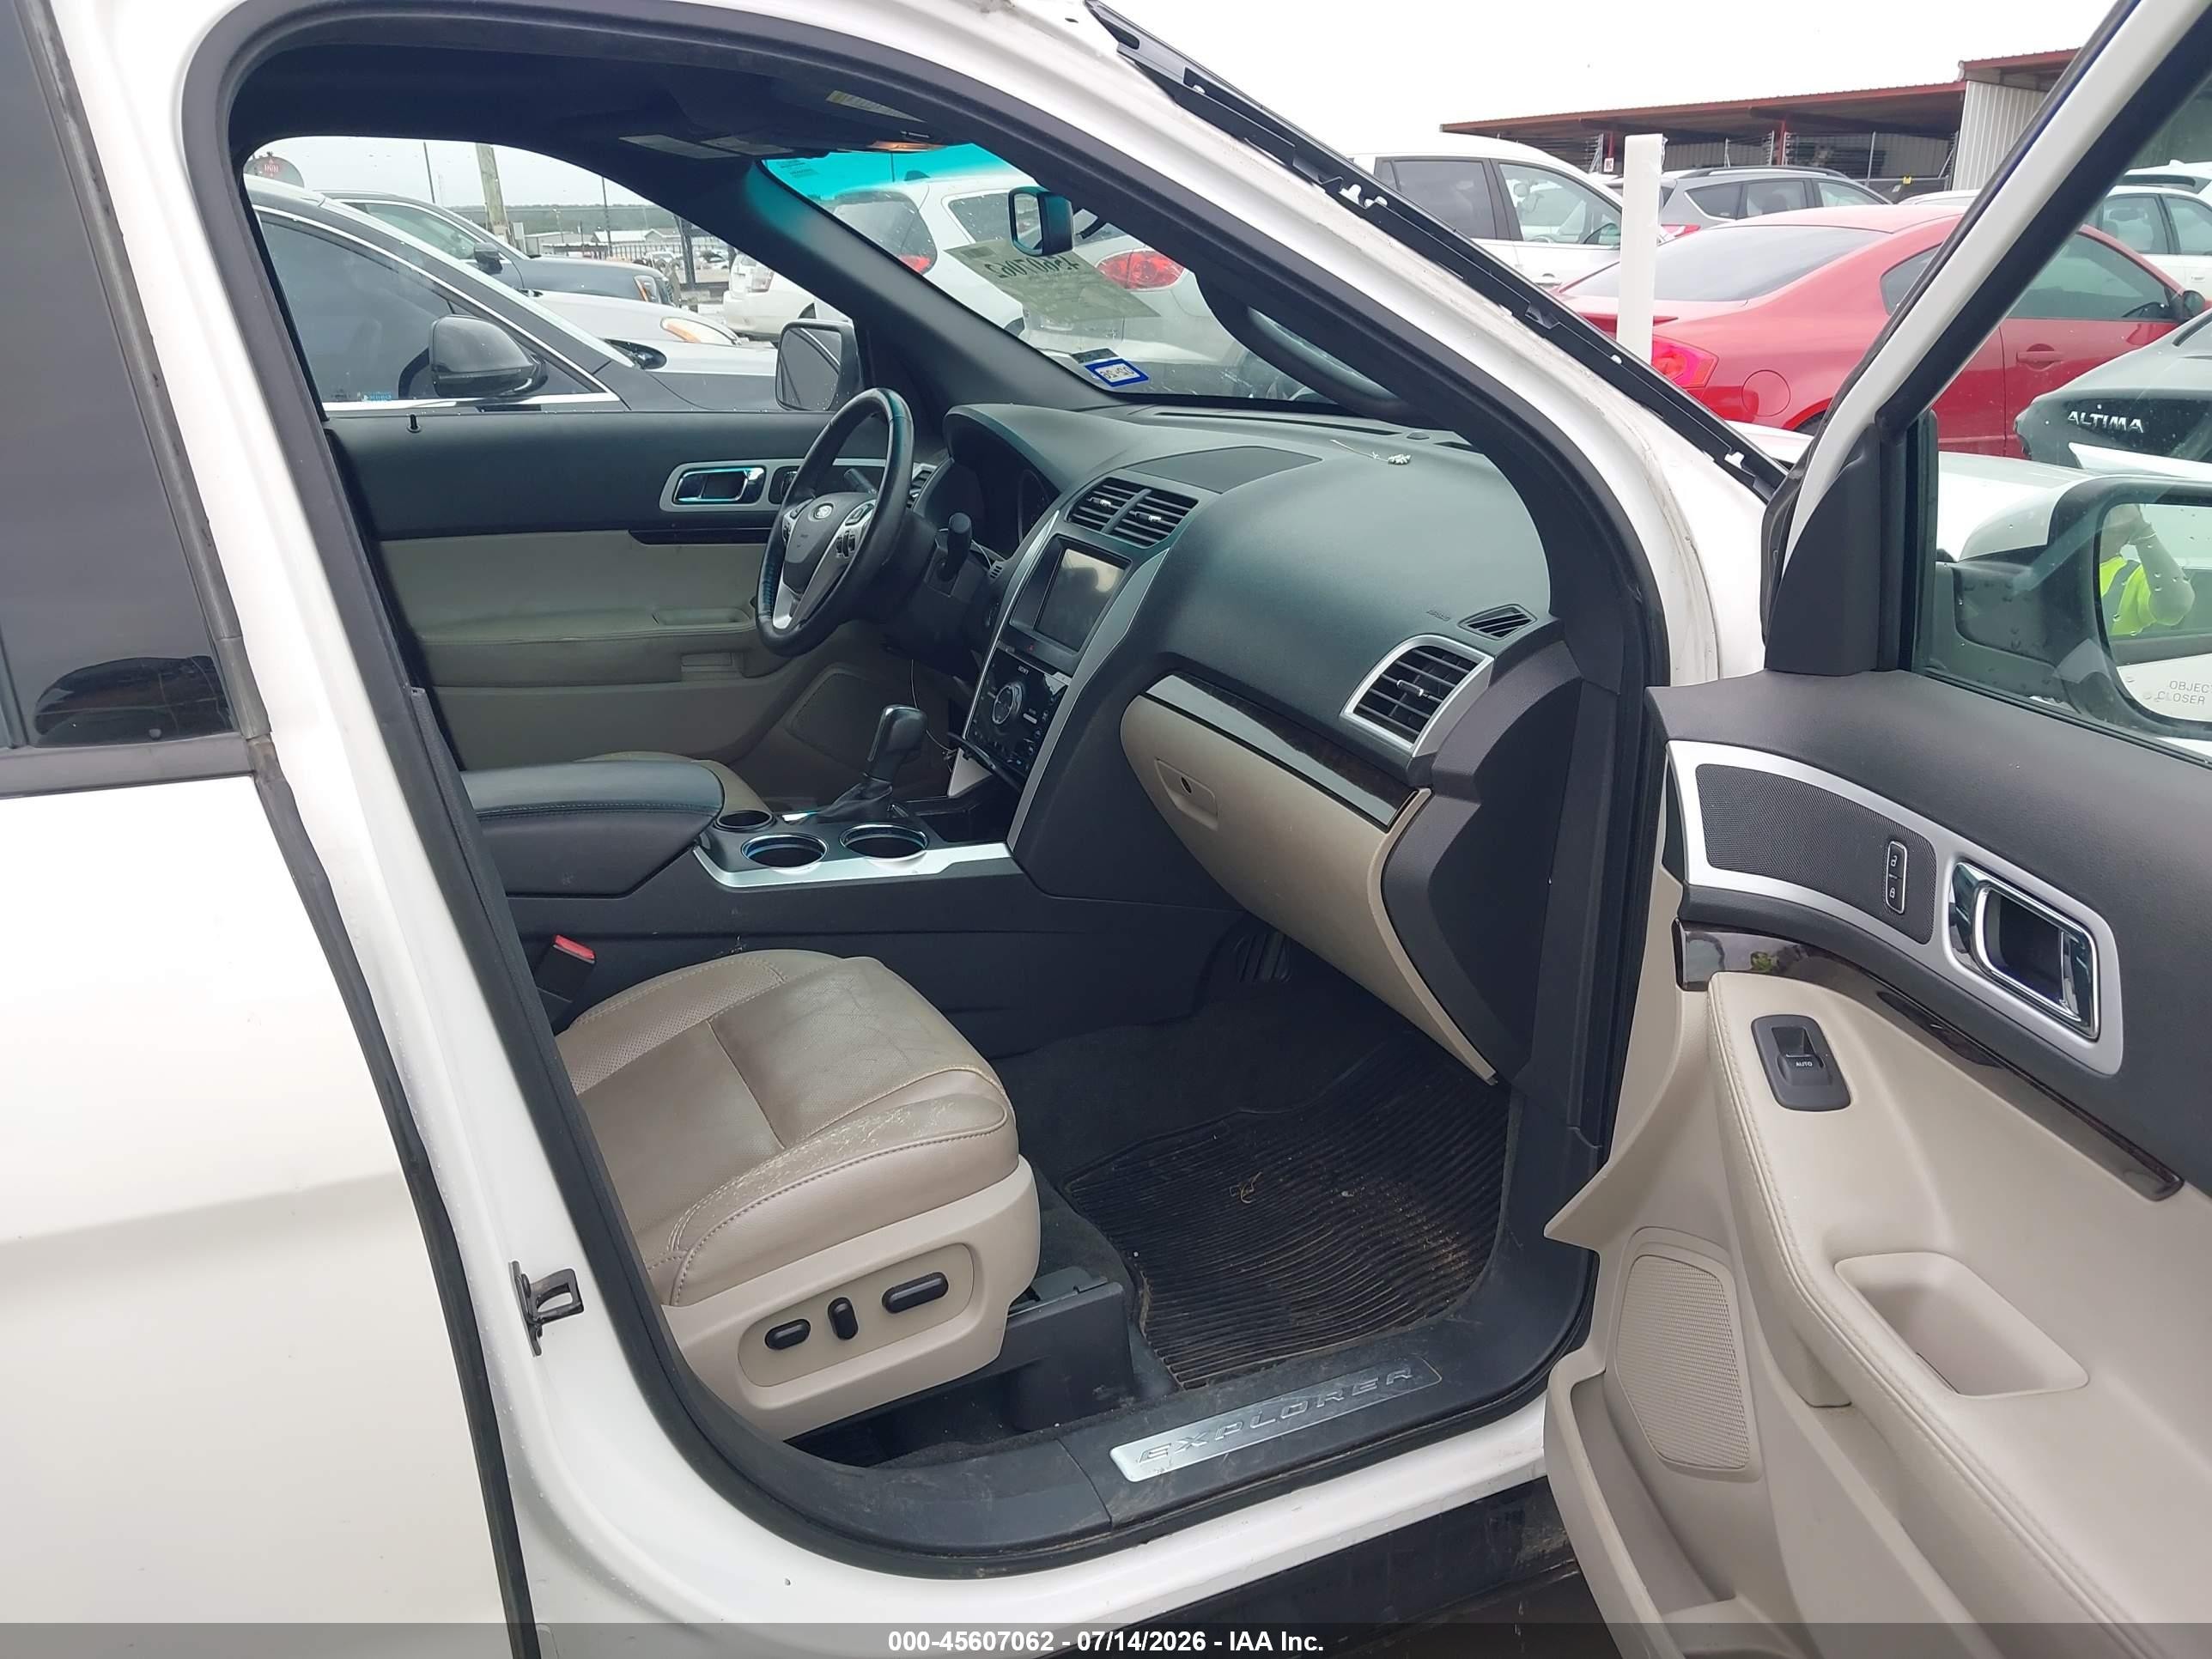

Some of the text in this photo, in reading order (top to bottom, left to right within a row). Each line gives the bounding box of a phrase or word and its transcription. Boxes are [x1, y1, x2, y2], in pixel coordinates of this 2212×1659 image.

[2068, 410, 2144, 433] ALTIMA
[2169, 680, 2212, 694] OBJEC
[2157, 690, 2206, 706] CLOSER
[1137, 1364, 1414, 1465] EXPLORER
